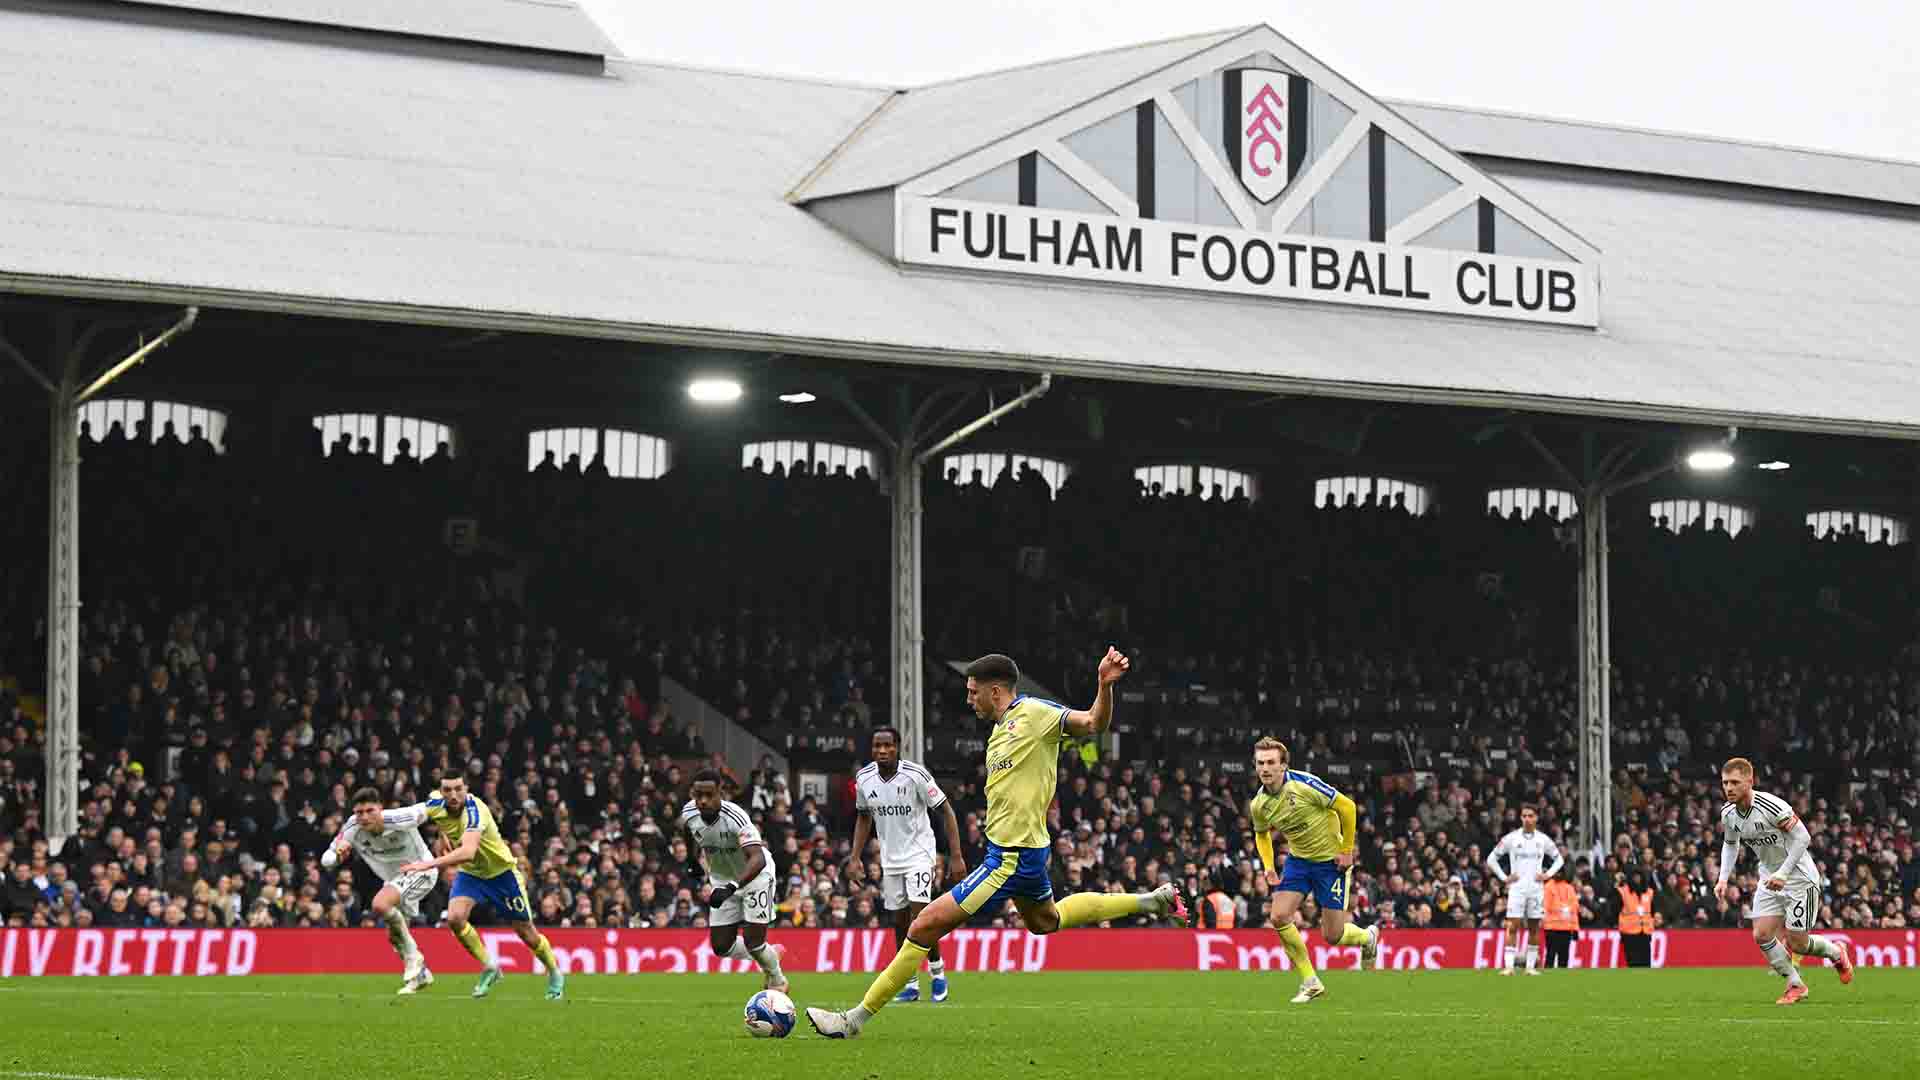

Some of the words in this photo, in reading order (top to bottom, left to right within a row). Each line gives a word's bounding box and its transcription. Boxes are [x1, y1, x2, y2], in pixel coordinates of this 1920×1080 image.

[929, 206, 1144, 273] FULHAM
[1170, 231, 1431, 300] FOOTBALL
[1455, 260, 1578, 313] CLUB
[915, 872, 931, 888] 19
[1330, 877, 1343, 897] 4
[749, 891, 768, 909] 30
[1793, 900, 1805, 919] 6
